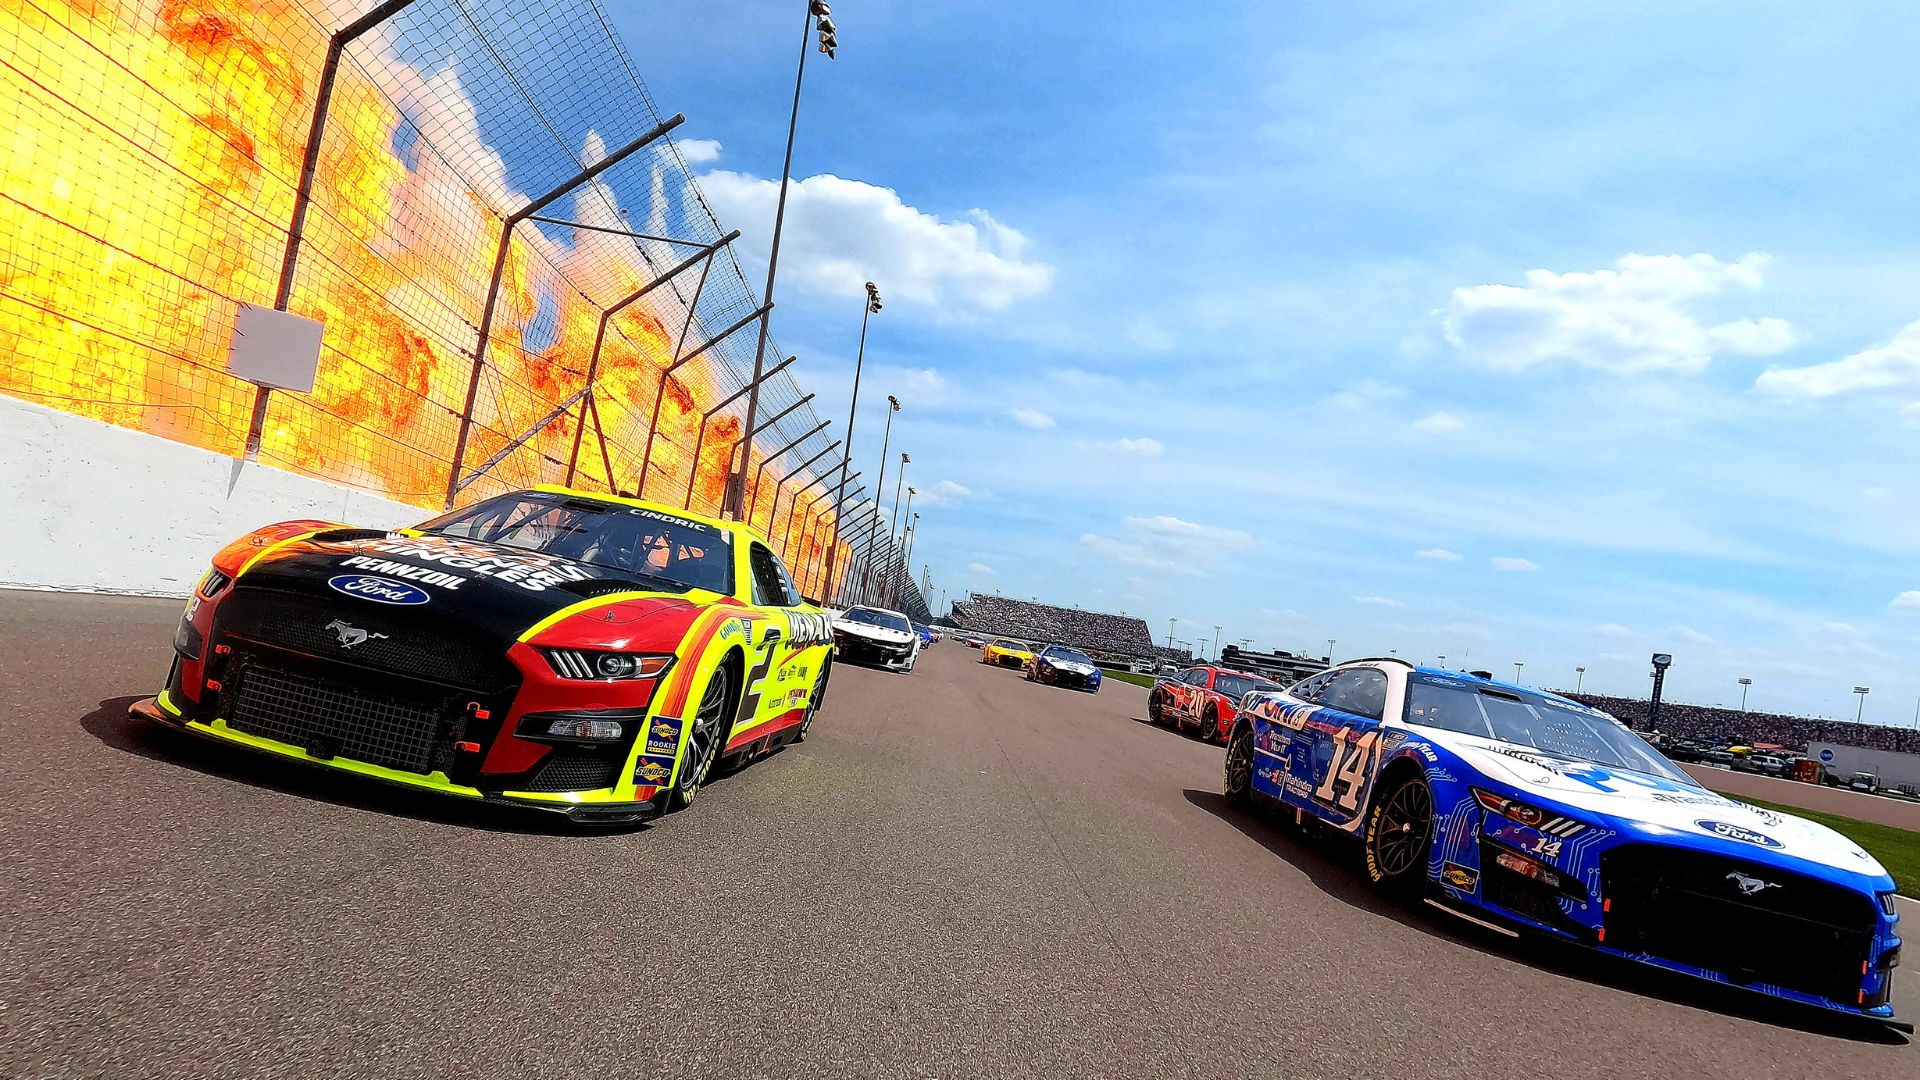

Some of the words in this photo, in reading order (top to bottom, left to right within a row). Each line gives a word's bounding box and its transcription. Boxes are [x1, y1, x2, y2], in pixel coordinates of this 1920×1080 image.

[629, 508, 707, 532] CINDRIC
[338, 555, 468, 590] PENNZOIL
[344, 577, 413, 601] Ford
[736, 624, 782, 727] 2
[1188, 689, 1205, 718] 20
[651, 724, 679, 736] SUNOCO
[647, 740, 677, 750] ROOKIE
[1399, 741, 1438, 762] YEAR
[635, 765, 672, 778] SUNOCO
[1315, 726, 1378, 811] 14
[1285, 772, 1313, 793] Mahindra
[1714, 822, 1769, 845] Ford
[1531, 837, 1562, 857] 14
[1442, 868, 1476, 885] SUNOCO
